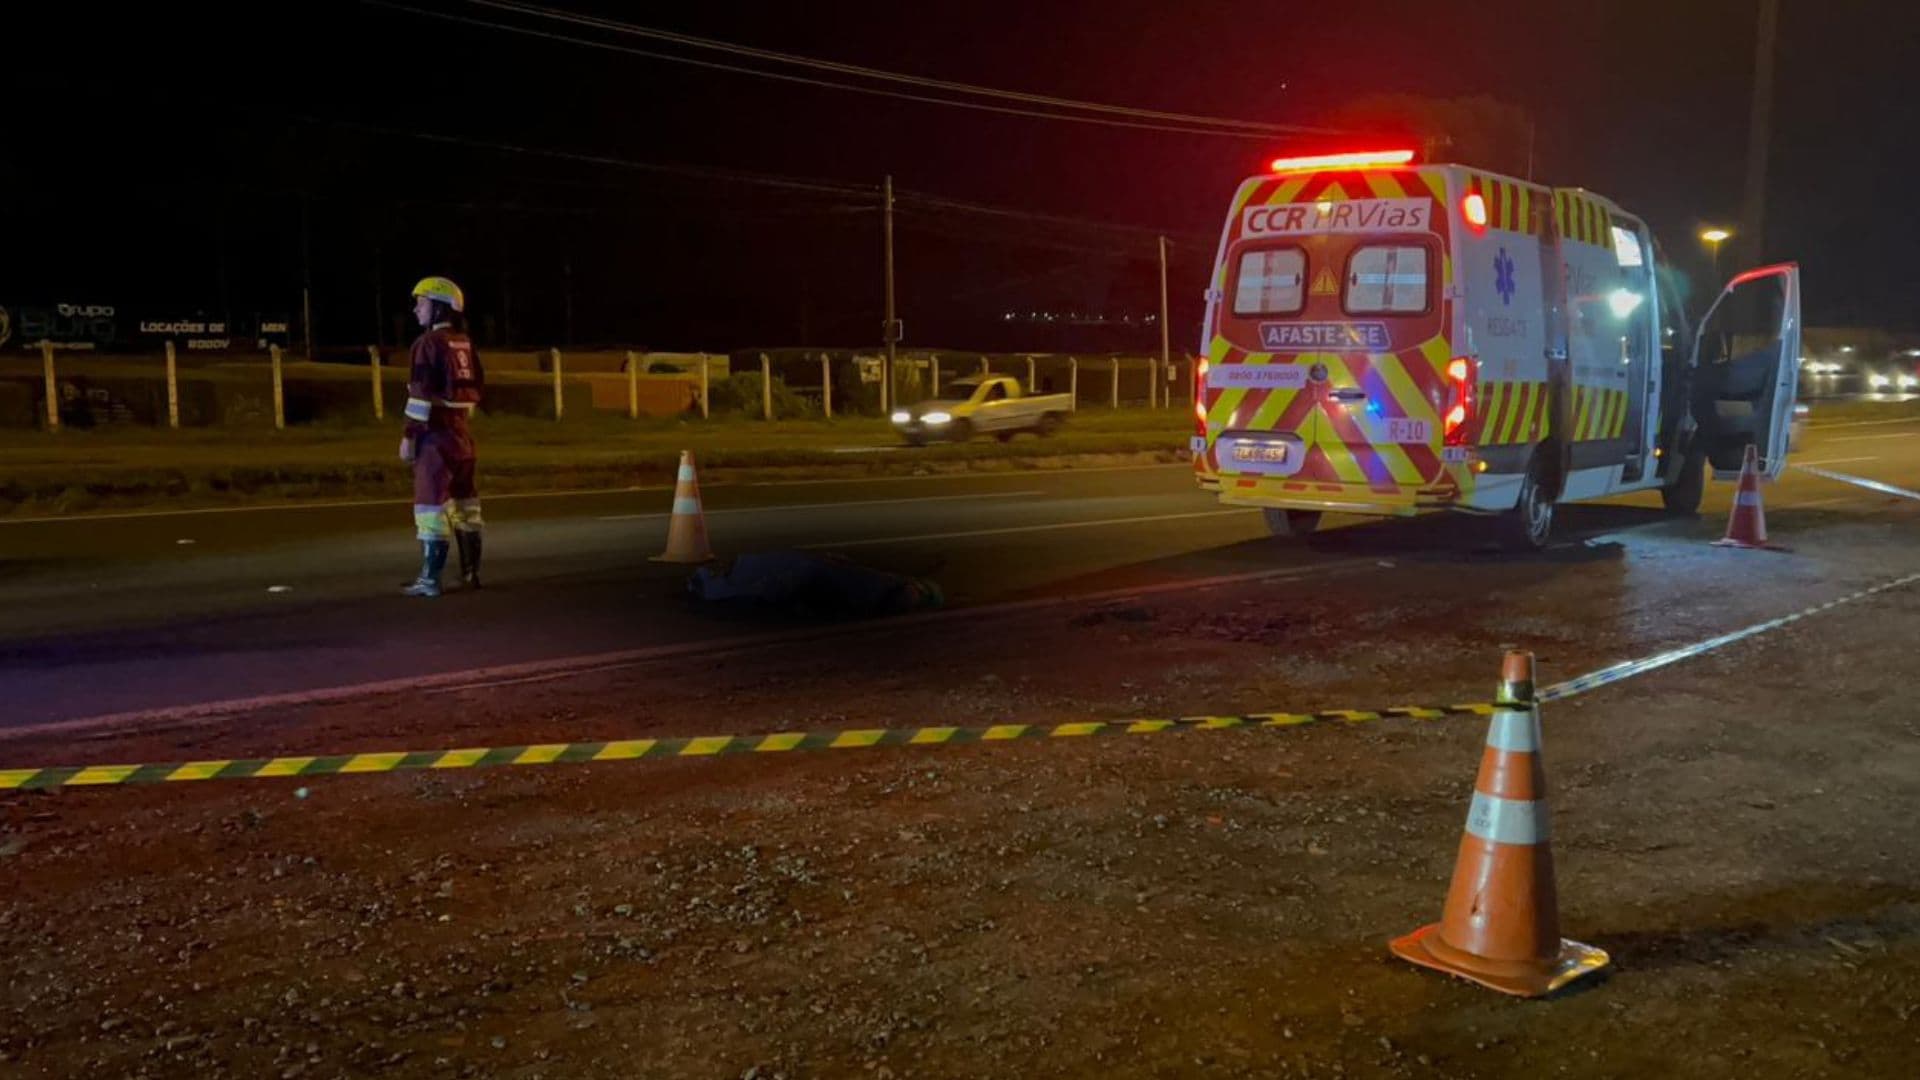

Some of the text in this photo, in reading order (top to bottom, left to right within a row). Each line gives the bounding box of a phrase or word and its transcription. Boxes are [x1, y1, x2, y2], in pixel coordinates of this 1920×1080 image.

[1247, 206, 1307, 233] CCR
[139, 319, 205, 336] LOCAÇÕES
[208, 322, 225, 333] DE
[1389, 421, 1424, 439] R-10
